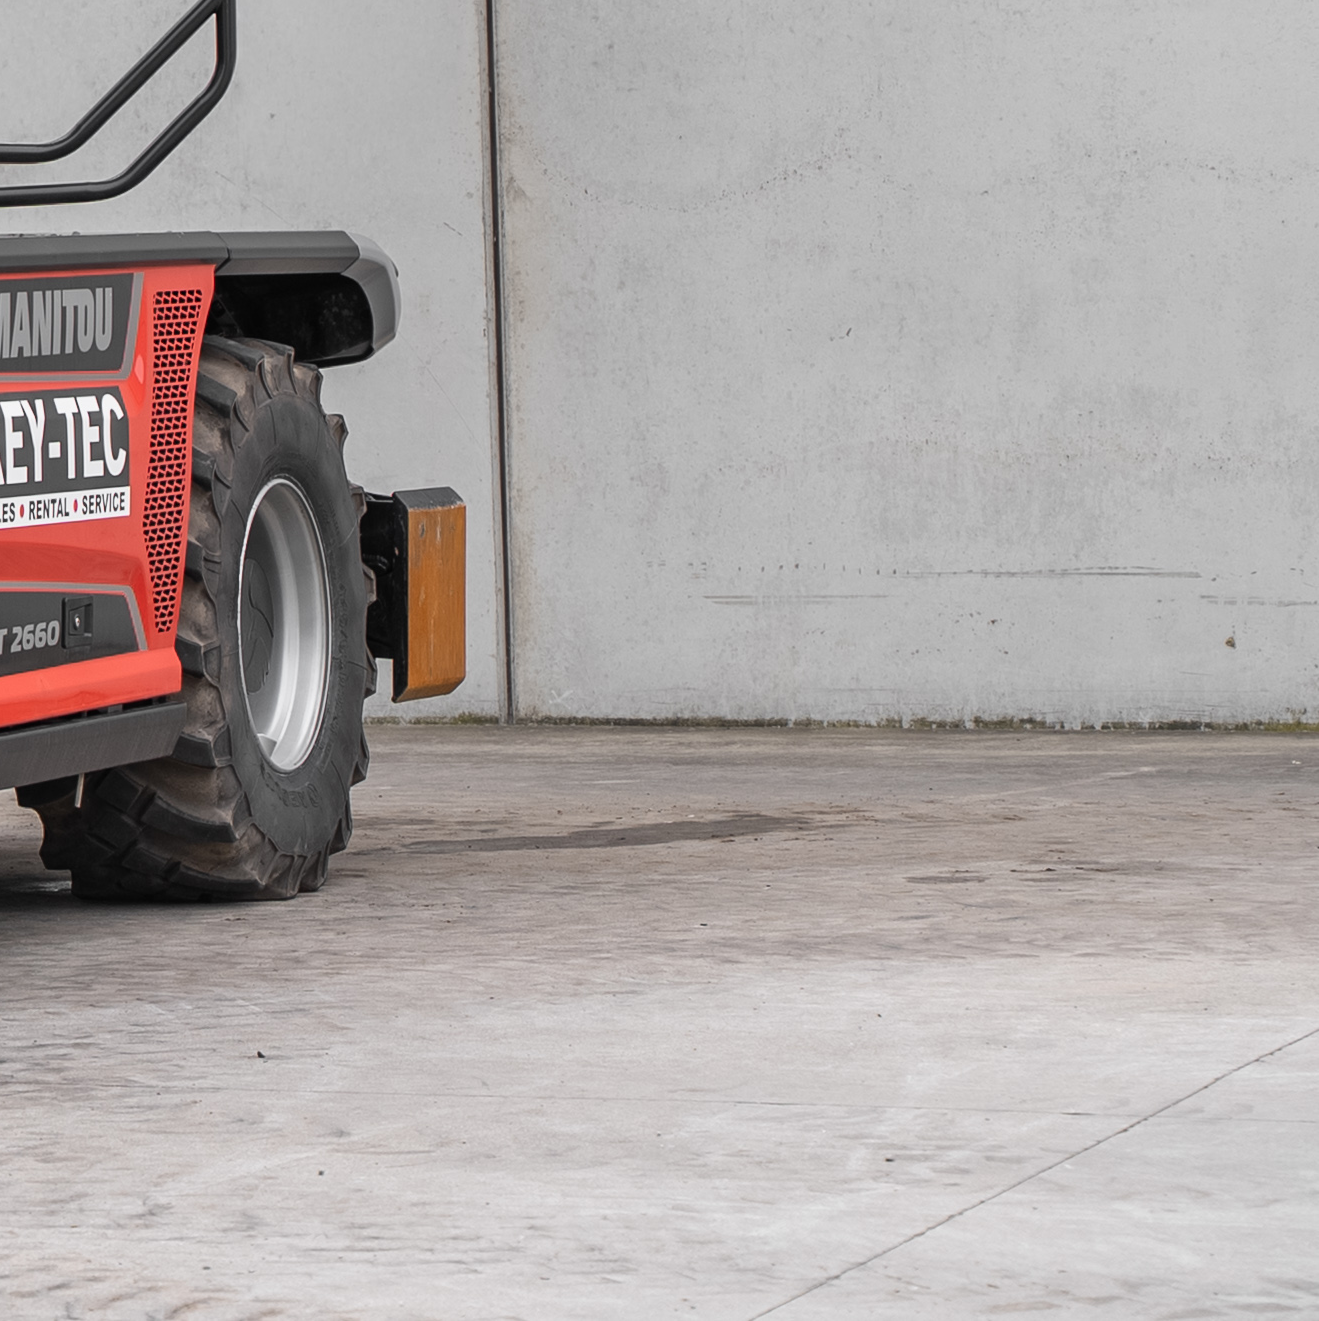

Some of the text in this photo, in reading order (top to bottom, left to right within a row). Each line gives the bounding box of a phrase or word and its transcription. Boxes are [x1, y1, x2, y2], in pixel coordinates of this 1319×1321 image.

[28, 497, 70, 521] RENTAL
[82, 492, 126, 516] SERVICE
[11, 620, 60, 653] 2660
